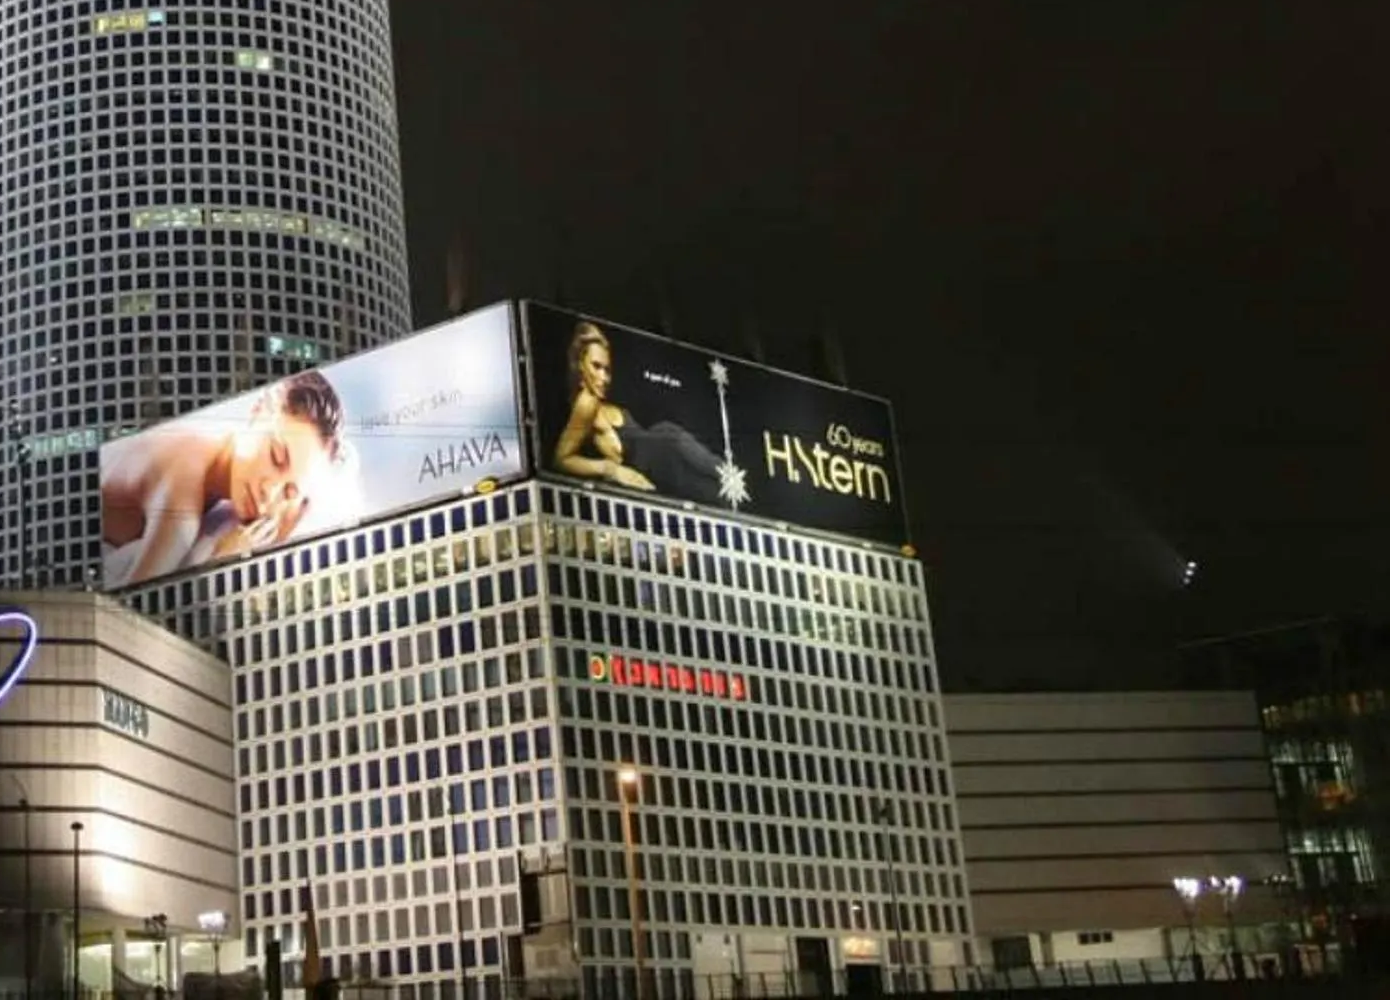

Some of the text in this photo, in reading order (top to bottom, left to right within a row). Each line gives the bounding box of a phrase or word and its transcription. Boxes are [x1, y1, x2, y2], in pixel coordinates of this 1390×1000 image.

[418, 431, 507, 483] AHAVA
[826, 422, 885, 458] 60 years
